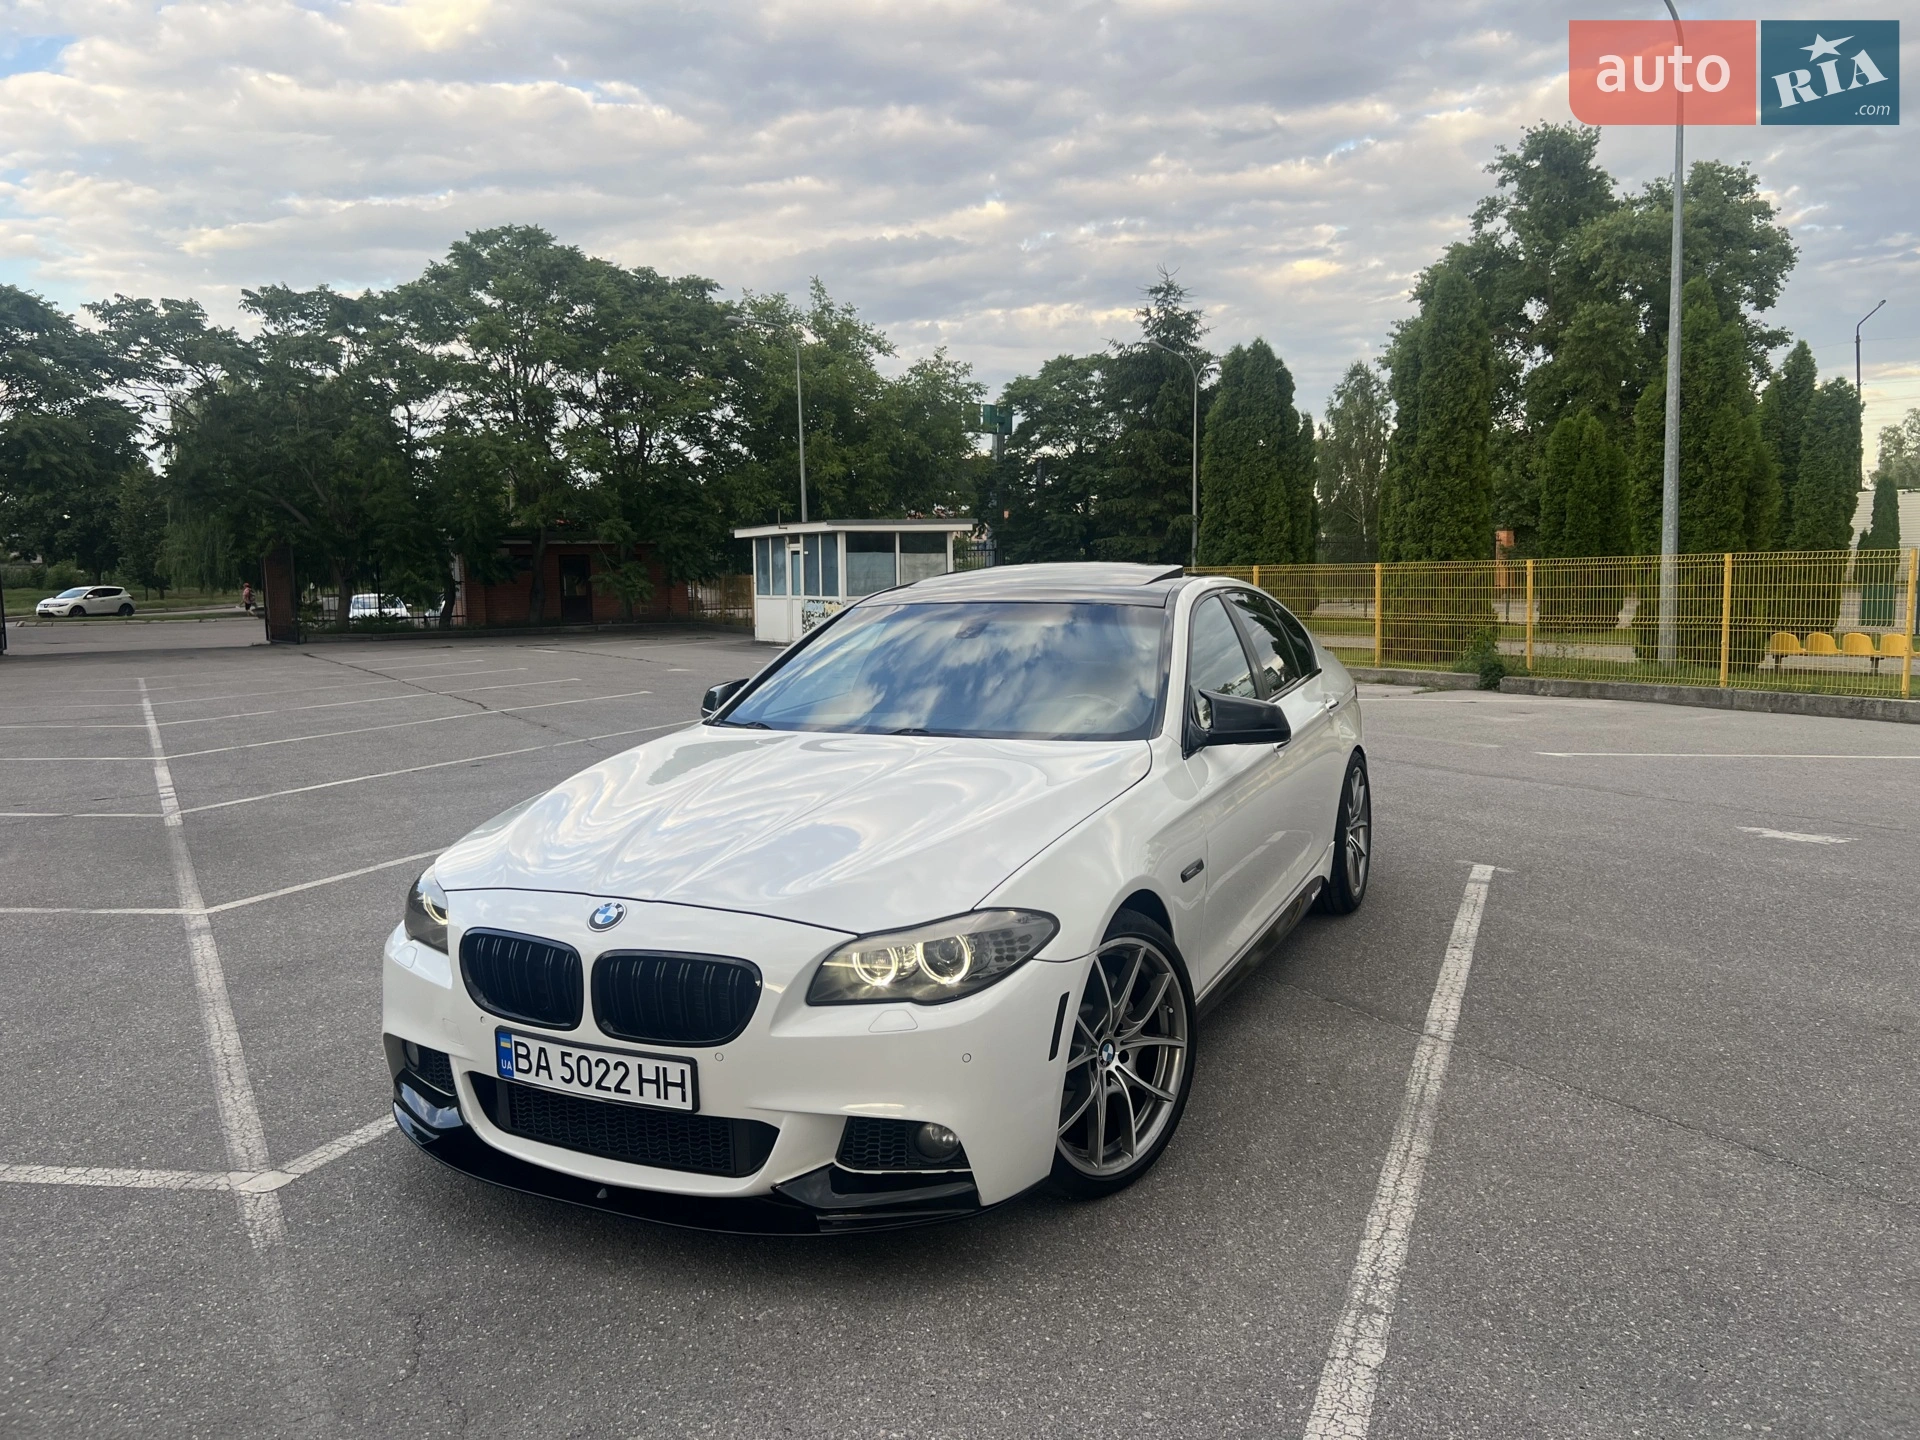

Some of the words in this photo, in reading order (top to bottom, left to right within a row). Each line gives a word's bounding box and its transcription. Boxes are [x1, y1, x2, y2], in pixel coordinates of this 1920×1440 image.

[501, 1058, 513, 1071] UA
[514, 1040, 553, 1081] BA
[560, 1050, 631, 1095] 5022
[638, 1063, 687, 1102] HH
